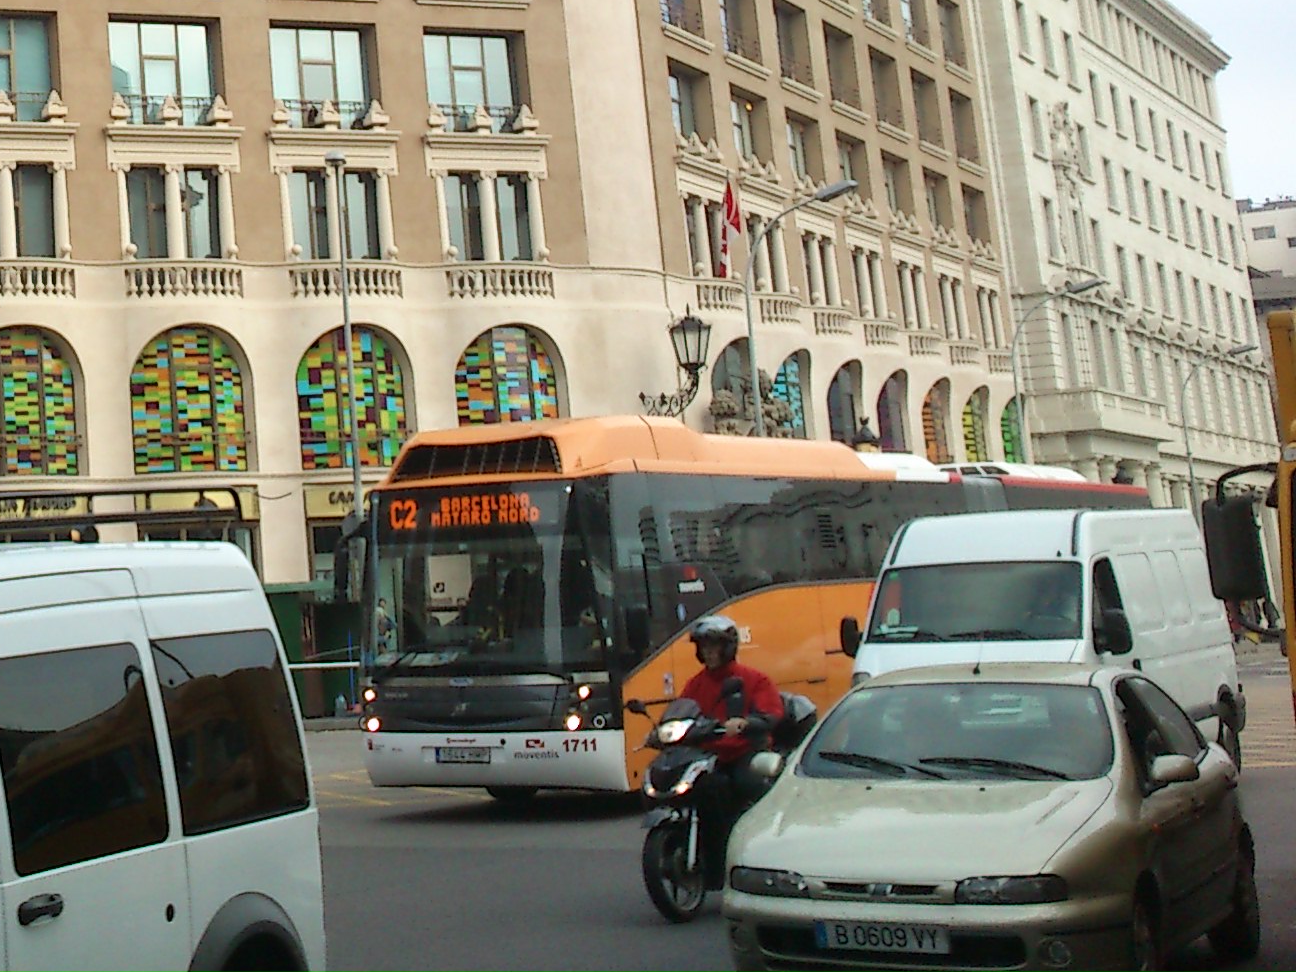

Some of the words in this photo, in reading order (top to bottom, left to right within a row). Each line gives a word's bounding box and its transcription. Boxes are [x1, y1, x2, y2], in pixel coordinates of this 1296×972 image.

[390, 499, 417, 530] C2
[440, 493, 529, 513] BARCELONA
[431, 510, 491, 527] MATARO
[498, 506, 540, 525] NORD
[513, 750, 560, 760] moventis
[562, 738, 597, 753] 1711
[835, 925, 849, 945] B
[854, 926, 908, 947] 0609
[913, 927, 937, 949] VY
